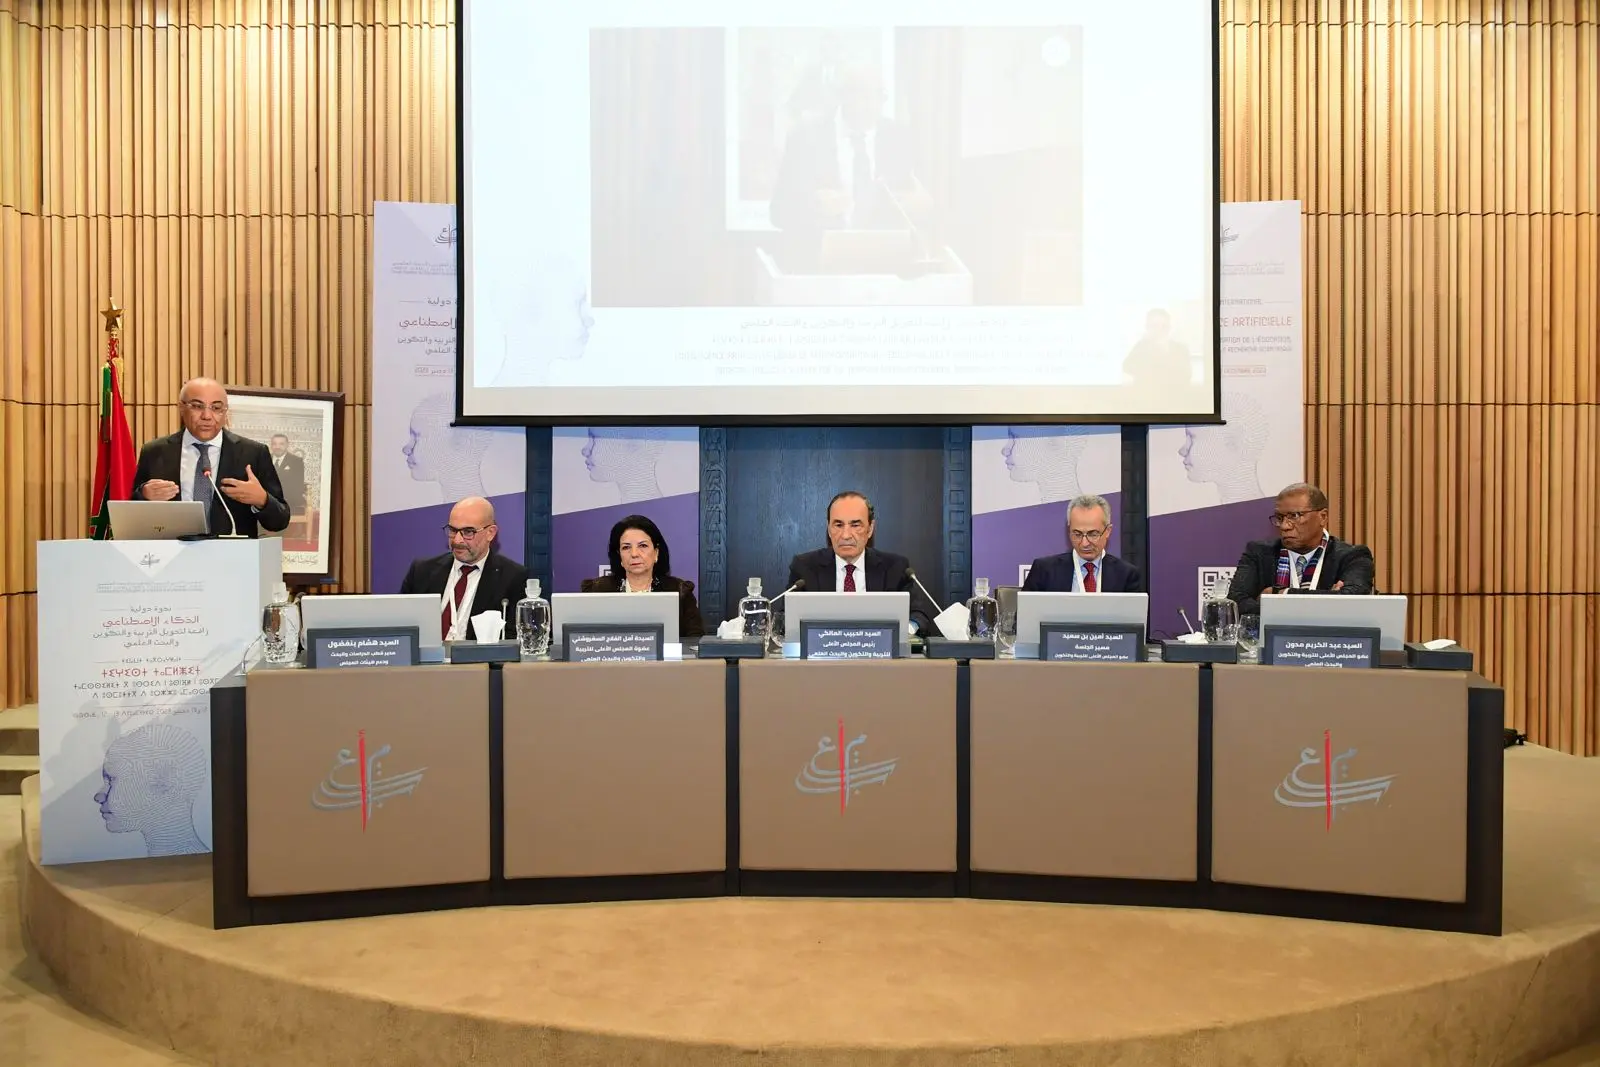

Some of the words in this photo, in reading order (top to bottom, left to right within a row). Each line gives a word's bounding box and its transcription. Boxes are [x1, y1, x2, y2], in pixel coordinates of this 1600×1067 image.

[1232, 316, 1292, 327] ARTIFICIELLE
[130, 605, 152, 613] دولية
[164, 615, 199, 625] الذكاء
[818, 630, 842, 638] المالكي
[843, 630, 863, 638] الحبيب
[1089, 632, 1104, 641] أمين
[606, 635, 622, 643] الفلاح
[623, 634, 633, 643] أمل
[327, 640, 356, 649] بنفضول
[358, 638, 378, 648] هشام
[379, 639, 399, 647] السيد
[823, 640, 839, 648] الأعلى
[861, 640, 876, 648] رئيس
[1285, 641, 1304, 649] مدون
[1305, 641, 1328, 650] الكريم
[594, 645, 611, 653] الأعلى
